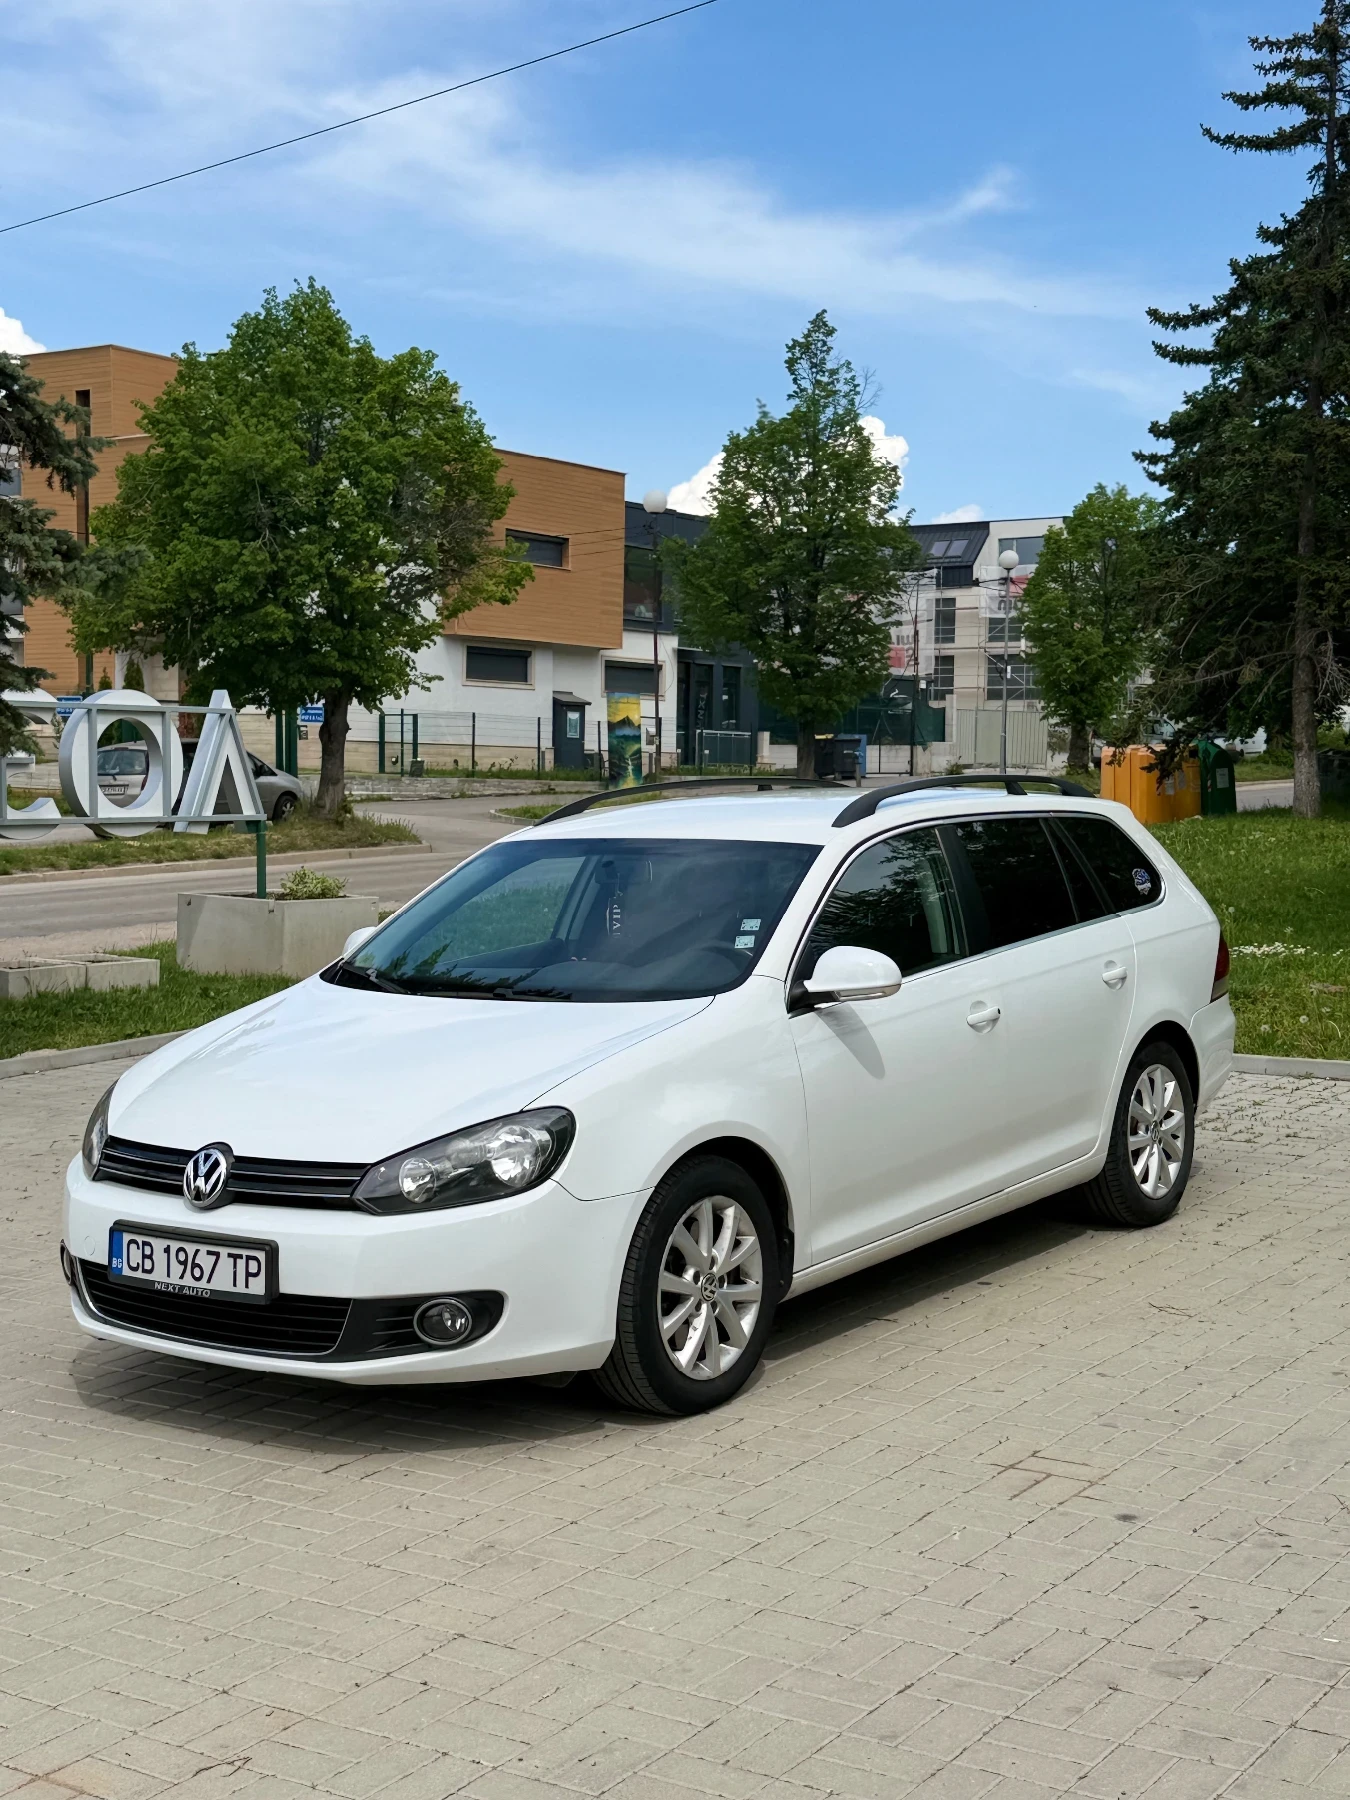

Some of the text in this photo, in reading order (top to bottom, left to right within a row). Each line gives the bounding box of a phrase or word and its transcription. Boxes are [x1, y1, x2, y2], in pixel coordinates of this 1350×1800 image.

[111, 1257, 123, 1268] BG
[126, 1238, 262, 1289] CB 1967 TP
[154, 1281, 211, 1298] NEXT AUTO
